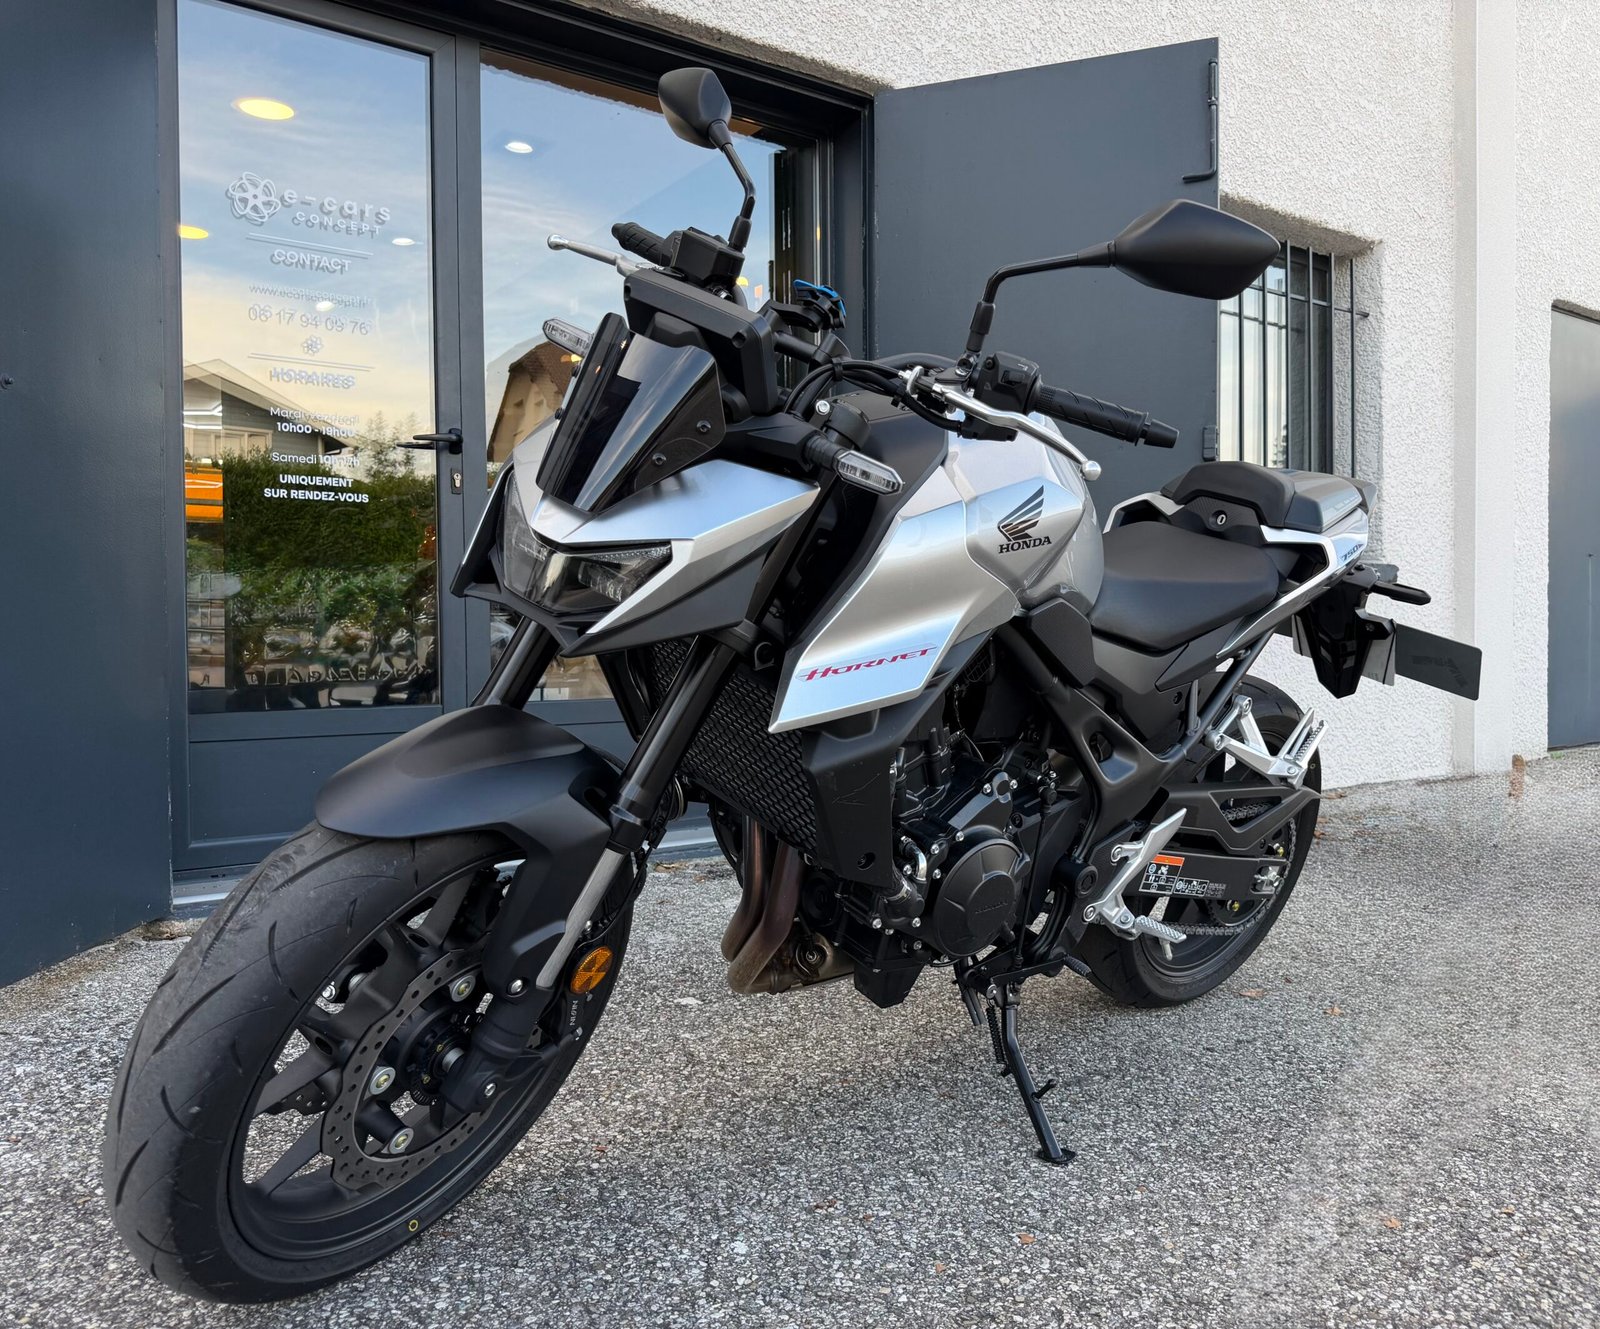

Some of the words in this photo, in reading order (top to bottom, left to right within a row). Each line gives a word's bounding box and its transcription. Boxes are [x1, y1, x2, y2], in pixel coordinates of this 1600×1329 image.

[282, 189, 391, 222] e-cars
[296, 211, 382, 235] CONCEPT
[273, 249, 351, 272] CONTACT
[270, 367, 355, 389] HORAIRES
[277, 422, 312, 434] 10h00
[322, 426, 355, 437] 19h00
[272, 452, 317, 464] Samedi
[280, 474, 354, 487] UNIQUEMENT
[264, 488, 288, 499] SUR
[290, 489, 369, 503] RENDEZ-VOUS
[998, 536, 1052, 554] HONDA
[1341, 545, 1359, 561] 750
[799, 646, 937, 681] HORNET
